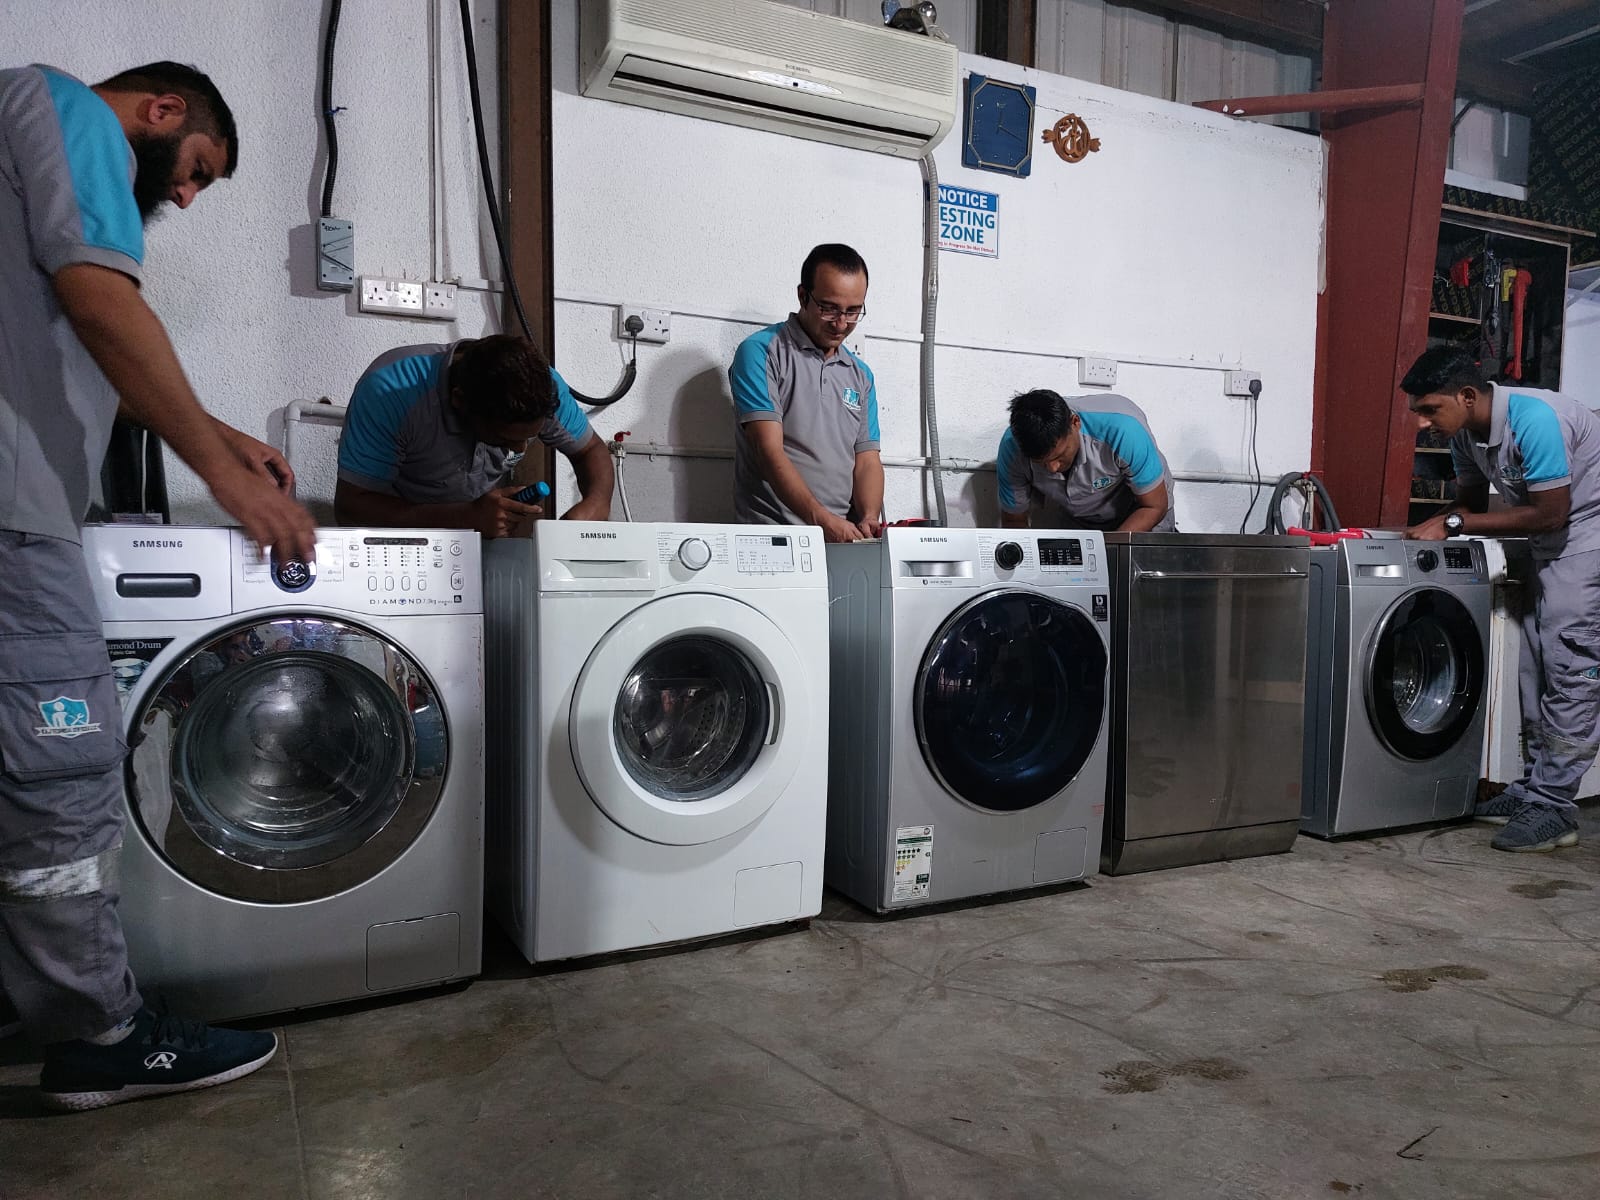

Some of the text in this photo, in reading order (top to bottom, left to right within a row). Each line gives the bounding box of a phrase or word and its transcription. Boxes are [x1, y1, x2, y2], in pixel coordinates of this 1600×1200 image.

[938, 188, 988, 209] NOTICE
[940, 206, 995, 229] ESTING
[941, 223, 984, 244] ZONE
[132, 540, 183, 548] SAMSUNG
[136, 641, 162, 649] Drum
